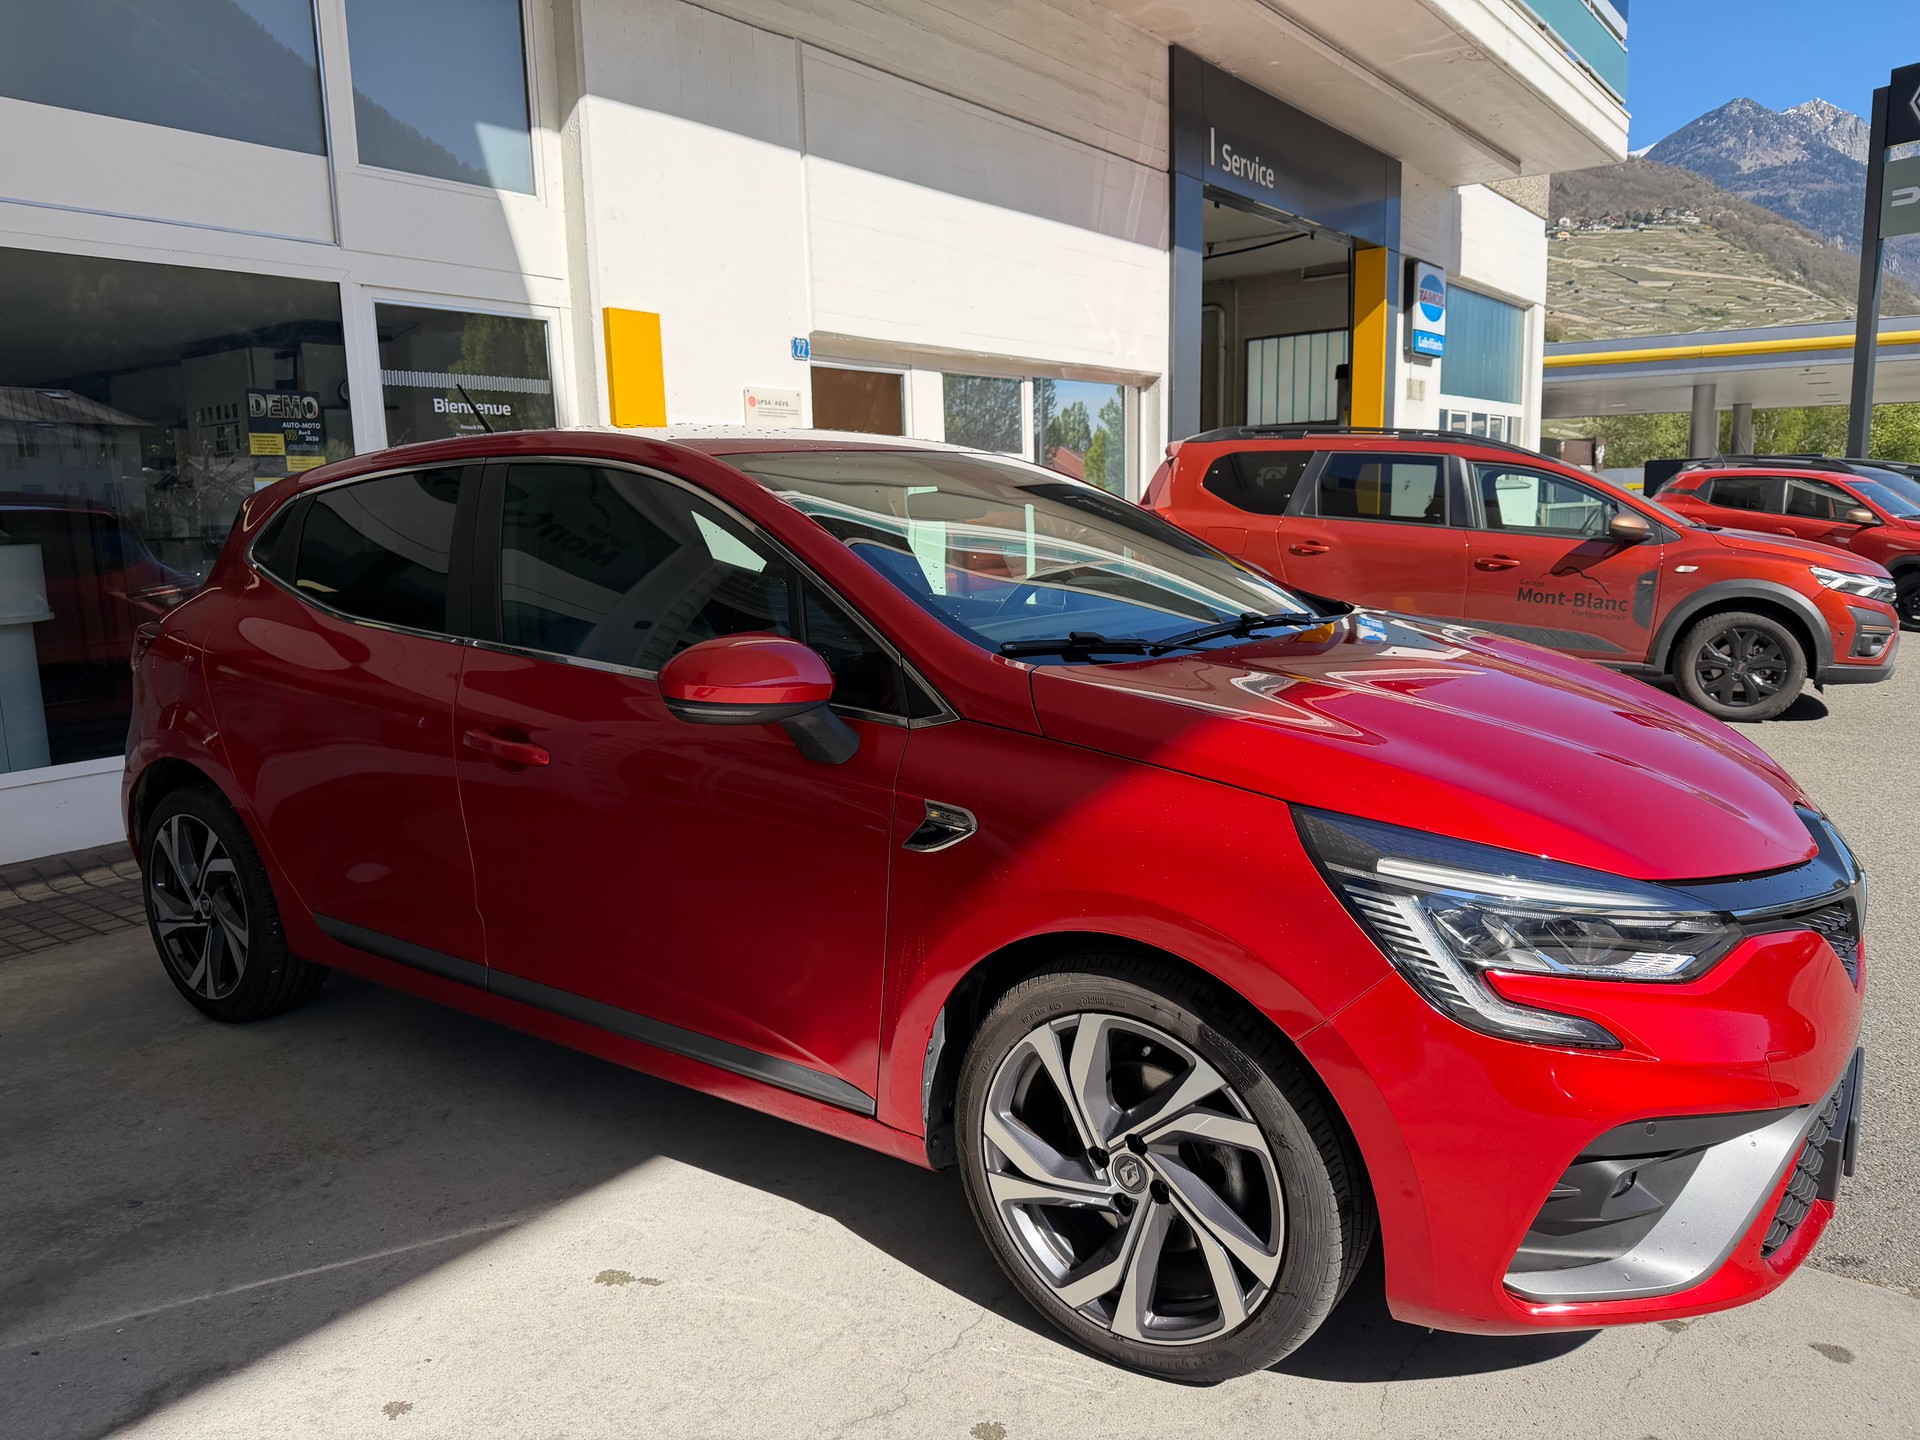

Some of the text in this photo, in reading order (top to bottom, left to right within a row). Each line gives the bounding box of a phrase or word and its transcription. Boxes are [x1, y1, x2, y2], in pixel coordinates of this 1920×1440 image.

[1222, 144, 1275, 189] Service
[1419, 289, 1445, 308] TAMOIL
[796, 340, 807, 357] 22
[248, 393, 319, 419] DEMO
[433, 397, 511, 416] Bienvenue
[281, 421, 321, 430] AUTO-MOTO
[284, 429, 298, 441] 18
[1519, 578, 1545, 587] Garage
[1517, 587, 1629, 612] Mont-Blanc
[1571, 609, 1626, 620] Martigny-Croix
